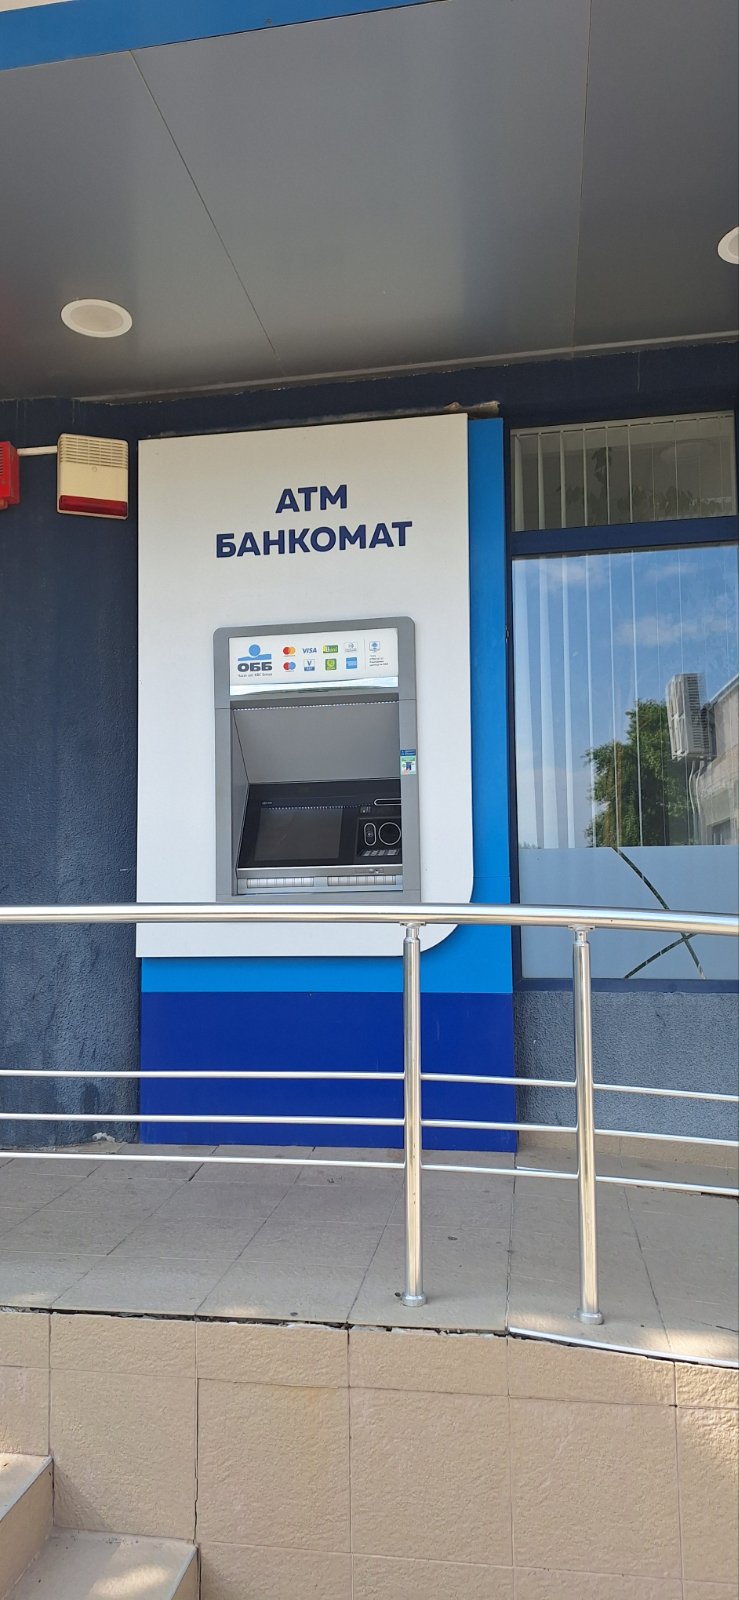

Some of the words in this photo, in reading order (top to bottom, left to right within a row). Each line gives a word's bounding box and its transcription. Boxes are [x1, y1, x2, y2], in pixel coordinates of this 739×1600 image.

[275, 484, 347, 513] ATM
[216, 521, 413, 558] БАНКОМАТ
[237, 662, 273, 672] ОББ
